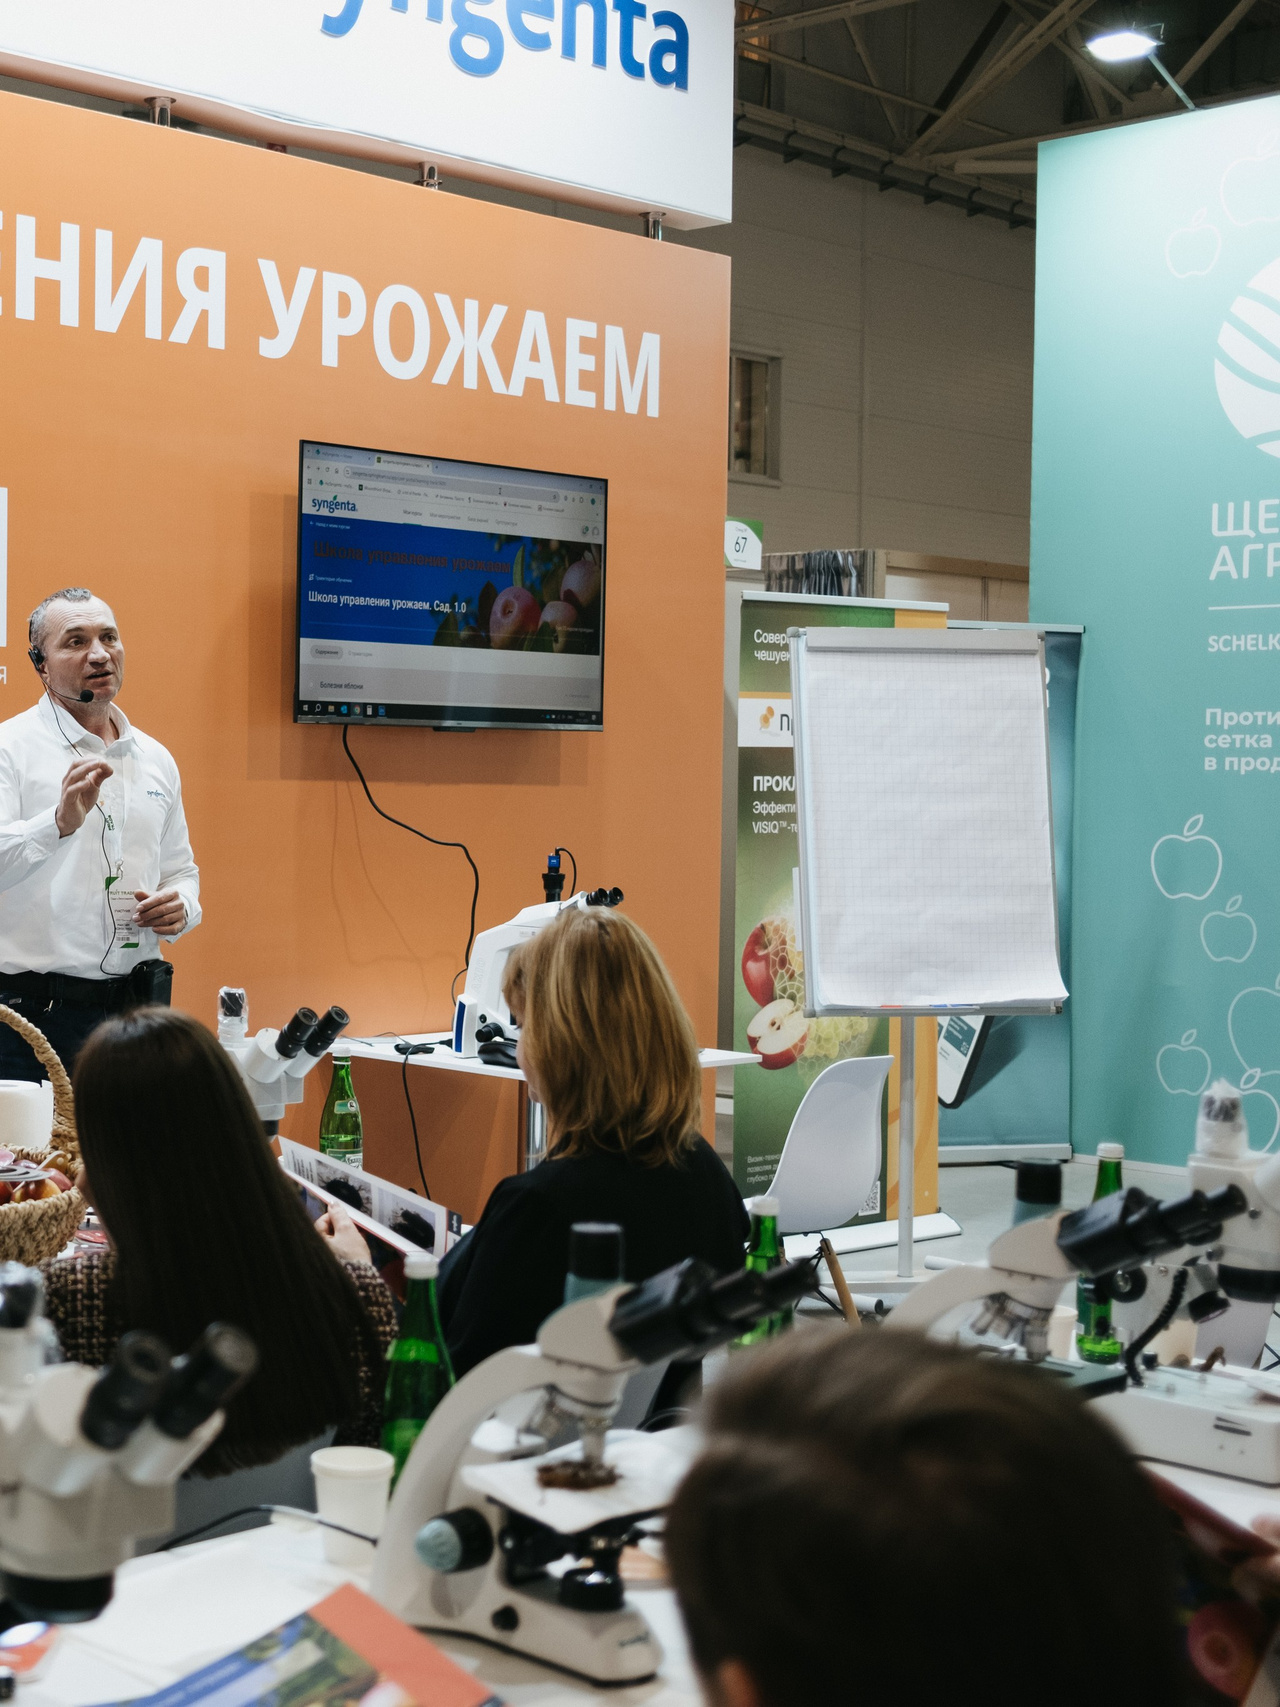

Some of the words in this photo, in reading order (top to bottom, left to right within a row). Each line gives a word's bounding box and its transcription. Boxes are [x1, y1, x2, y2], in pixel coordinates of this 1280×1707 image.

[257, 258, 661, 419] УРОЖАЕМ
[312, 497, 357, 514] syngenta
[734, 536, 747, 553] 67
[314, 541, 363, 561] Школа
[367, 545, 448, 568] управления
[451, 557, 510, 574] урожаем
[308, 591, 338, 604] Школа
[339, 594, 390, 609] управления
[391, 599, 432, 613] урожаем.
[433, 600, 452, 614] Сад.
[453, 603, 467, 614] 1.0
[754, 628, 790, 647] Совер
[320, 680, 343, 690] Болезни
[344, 681, 364, 691] яблони
[1203, 733, 1272, 750] сетка
[1204, 757, 1217, 771] в
